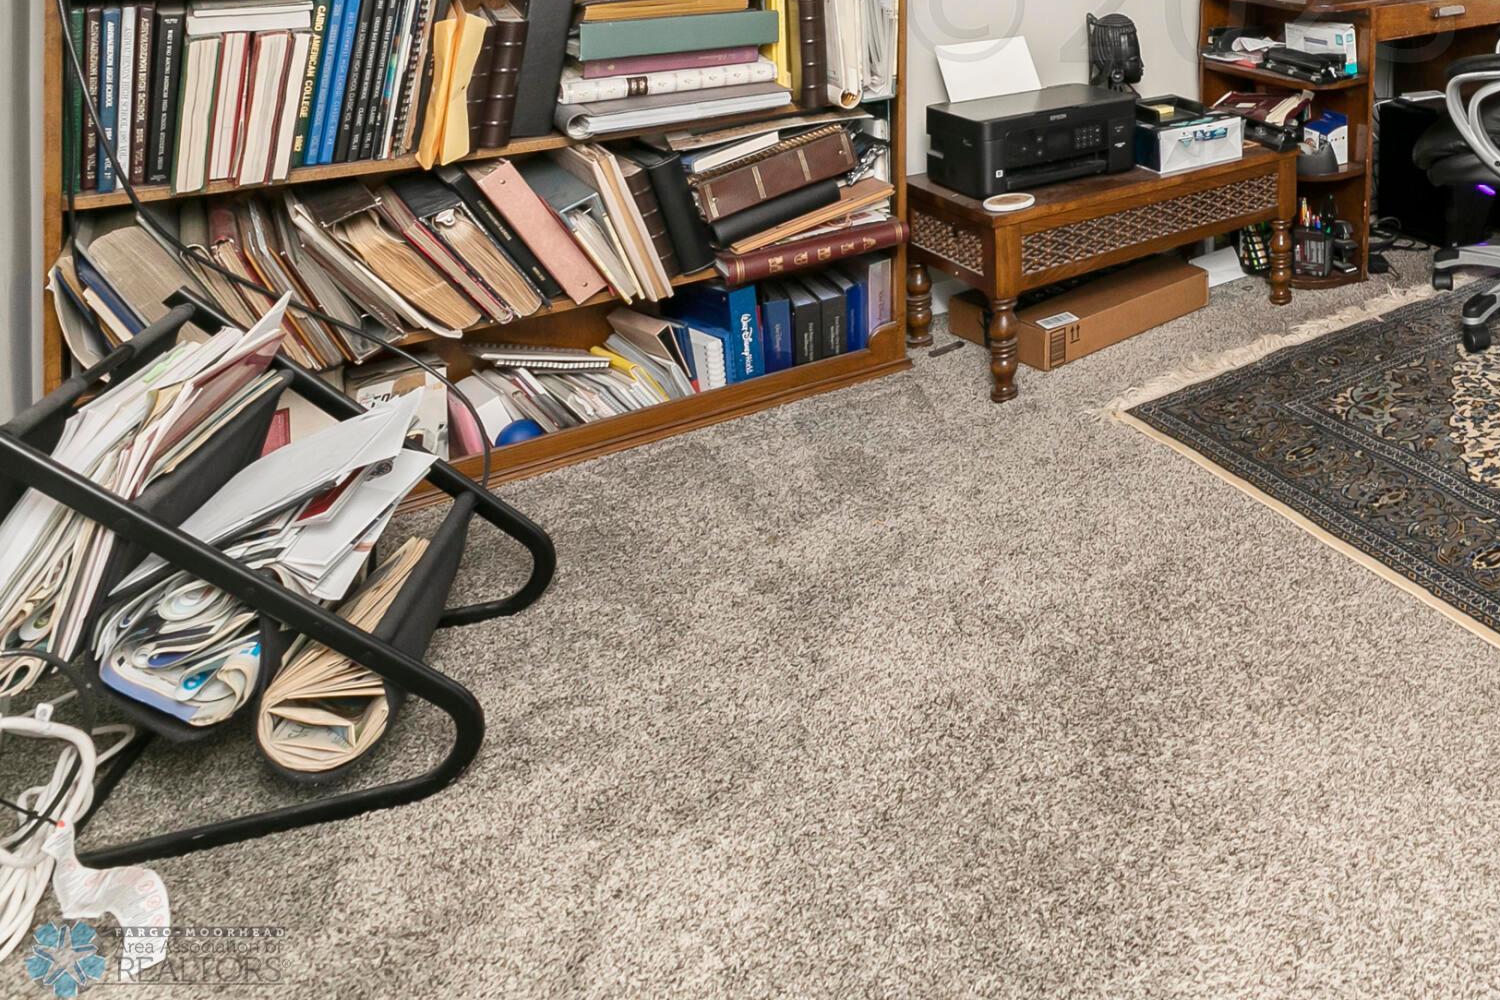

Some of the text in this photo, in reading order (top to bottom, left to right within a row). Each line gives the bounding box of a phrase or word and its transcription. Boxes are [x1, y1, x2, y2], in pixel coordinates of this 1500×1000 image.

[314, 5, 327, 31] CAIRO
[307, 34, 322, 77] AMERICAN
[299, 80, 313, 118] COLLEGE
[741, 327, 753, 357] Disney
